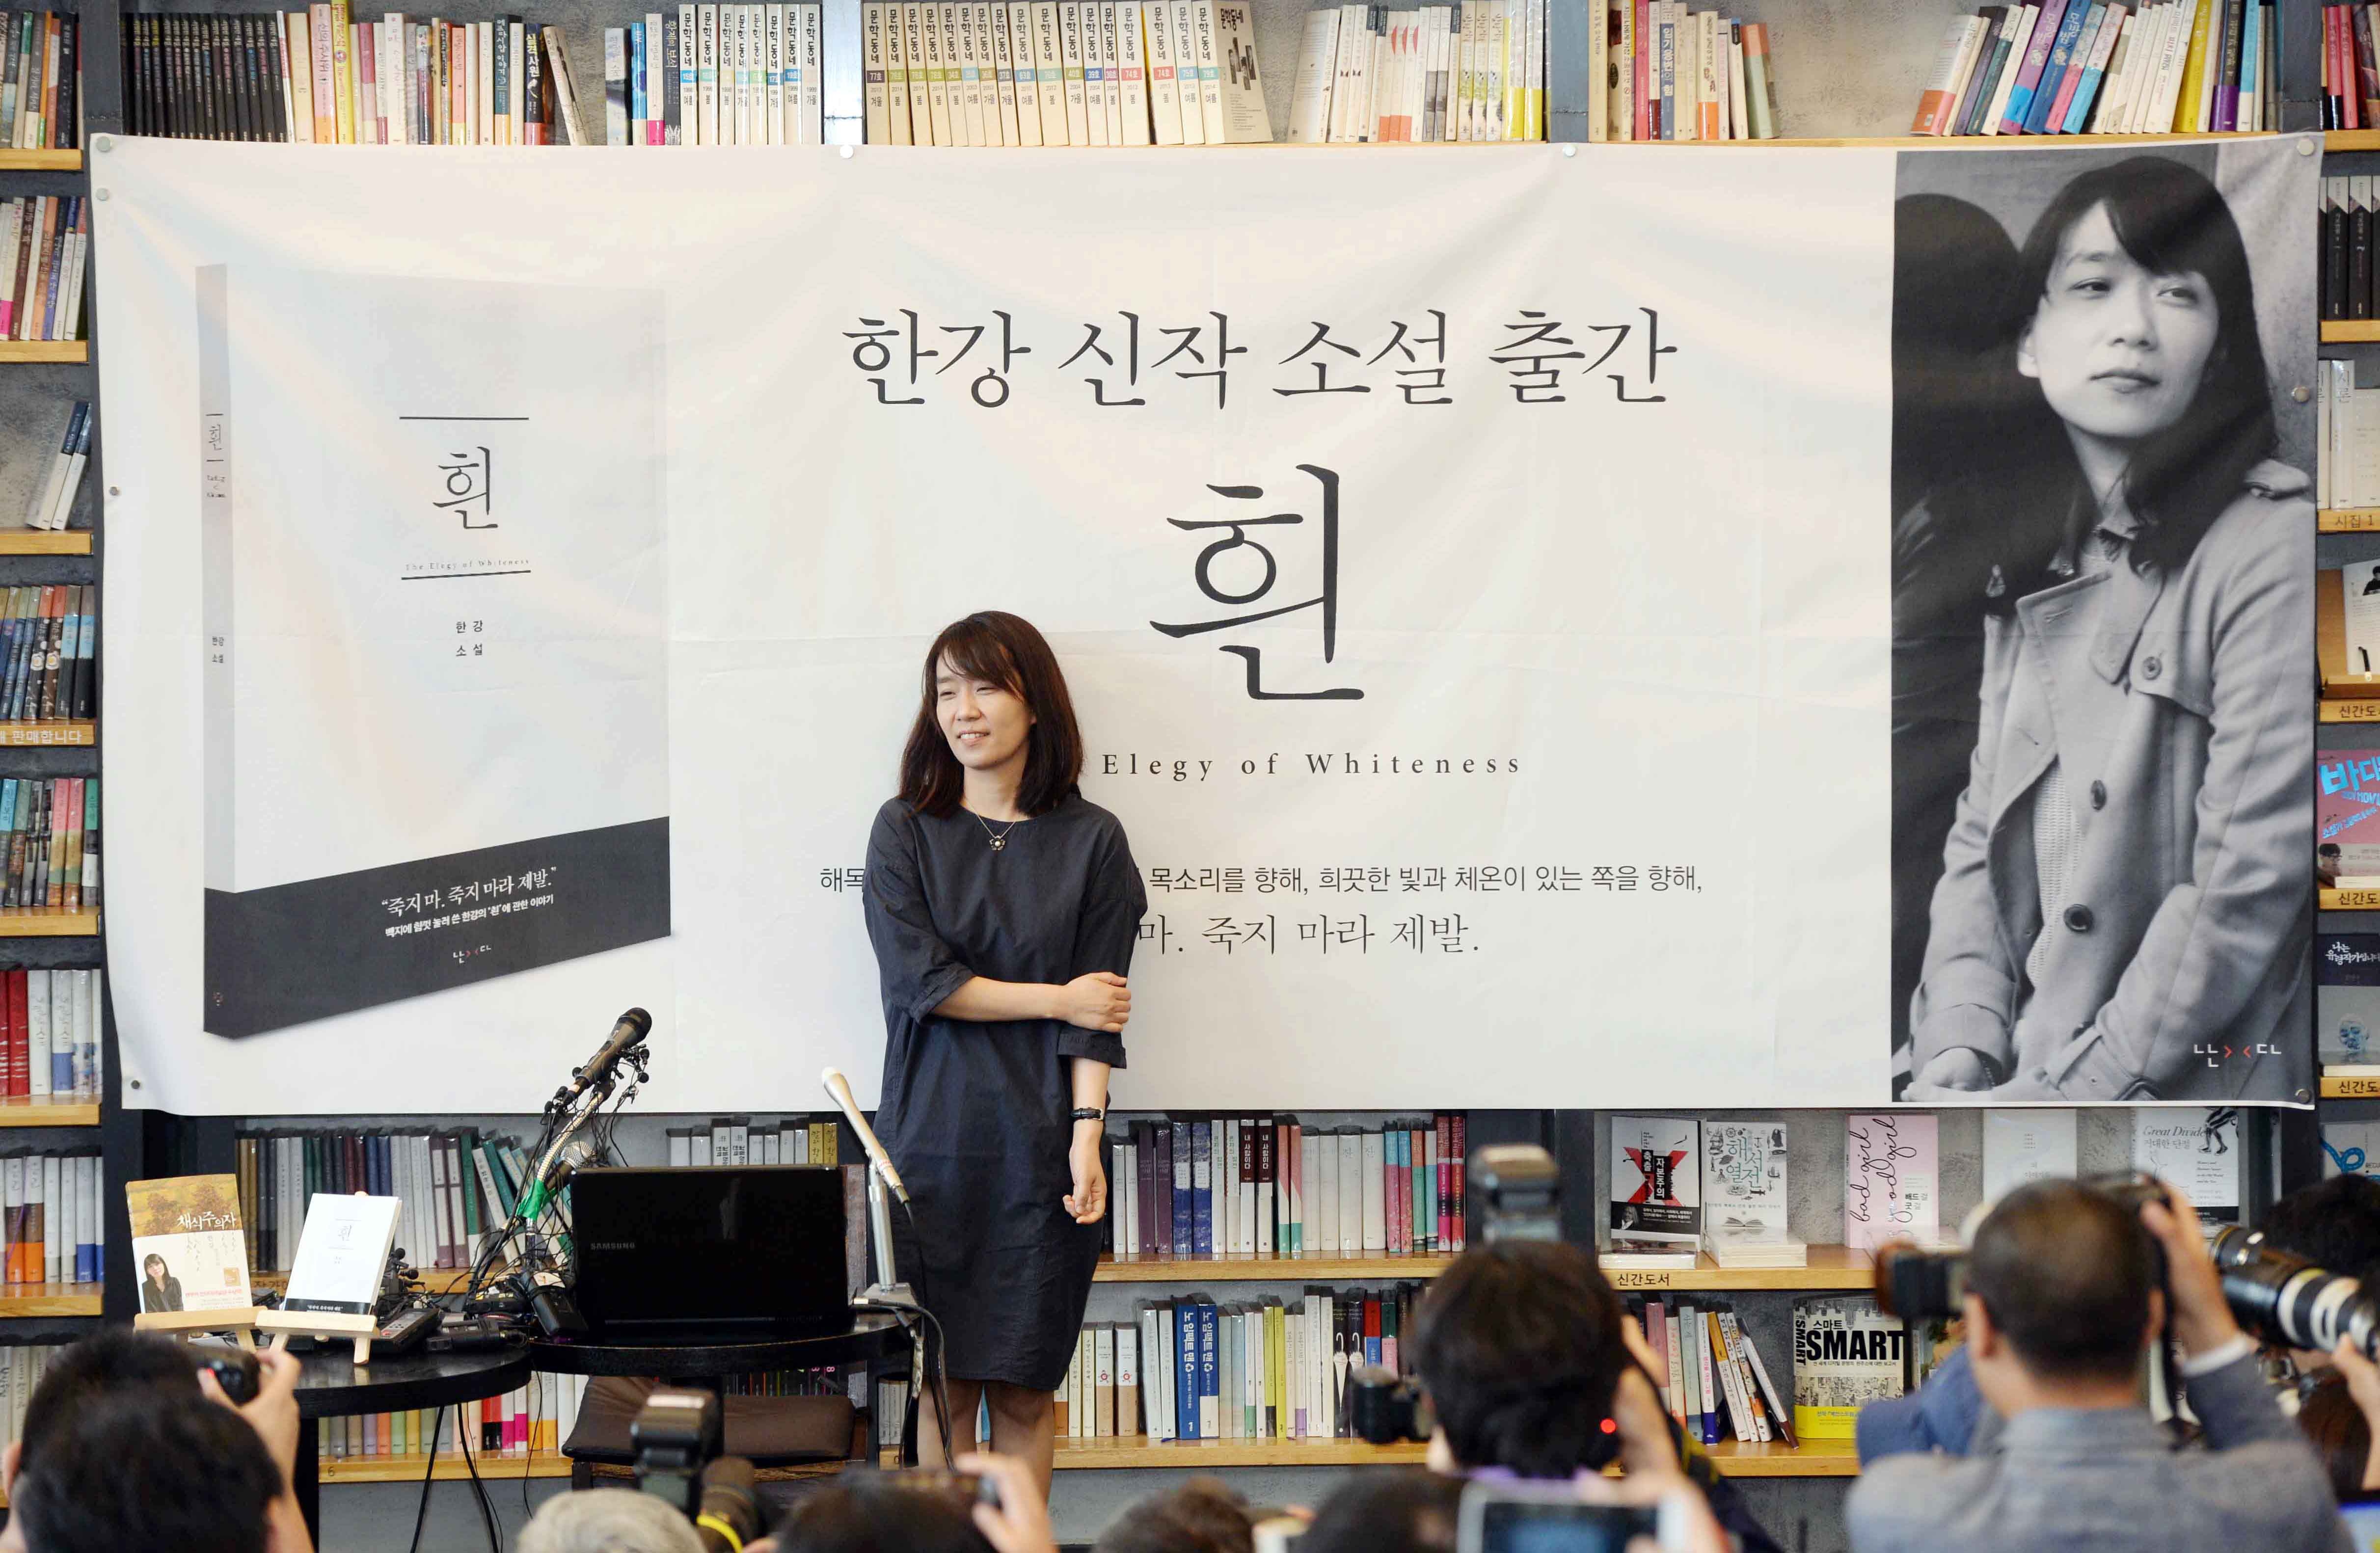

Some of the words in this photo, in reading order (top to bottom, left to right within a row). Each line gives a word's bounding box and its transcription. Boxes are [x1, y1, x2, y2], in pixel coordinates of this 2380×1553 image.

[869, 10, 880, 63] 문학동네
[889, 9, 899, 62] 문학동네
[909, 9, 919, 61] 문학동네
[926, 9, 938, 61] 문학동네
[945, 8, 956, 61] 문학동네
[962, 8, 973, 61] 문학동네
[977, 8, 989, 61] 문학동네
[995, 9, 1007, 61] 문학동네
[1016, 9, 1028, 61] 문학동네
[1041, 8, 1053, 61] 문학동네
[1066, 6, 1077, 59] 문학동네
[1086, 7, 1097, 60] 문학동네
[1104, 7, 1115, 60] 문학동네
[1124, 7, 1135, 60] 문학동네
[1154, 7, 1165, 59] 문학동네
[1179, 7, 1190, 59] 문학동네
[1199, 7, 1211, 60] 문학동네
[842, 309, 1031, 407] 한강
[1058, 311, 1247, 409] 신작
[1272, 310, 1452, 404] 소설
[1488, 307, 1677, 402] 출간
[433, 447, 498, 529] 흰
[2335, 515, 2360, 528] 시집
[1150, 464, 1364, 700] 흰
[2339, 705, 2380, 718] 신간도
[11, 730, 82, 744] 판매합니다
[1102, 753, 1212, 781] Elegy
[1242, 753, 1278, 774] of
[1305, 753, 1517, 774] Whiteness
[424, 889, 445, 910] 마.
[447, 882, 479, 906] 죽지
[483, 875, 514, 898] 마라
[1150, 868, 1246, 891] 목소리를
[1255, 867, 1310, 893] 향해,
[1318, 867, 1390, 892] 희끗한
[1399, 867, 1446, 892] 빛과
[1455, 867, 1526, 892] 체온이
[1534, 867, 1582, 892] 있는
[1590, 867, 1639, 892] 쪽을
[1647, 866, 1704, 893] 향해,
[2339, 893, 2380, 905] 신간도
[385, 923, 412, 938] 백지에
[461, 908, 487, 923] 한강의
[512, 899, 529, 911] 관한
[530, 894, 554, 907] 이야기
[1202, 914, 1278, 955] 죽지
[1297, 914, 1376, 954] 마라
[1391, 914, 1479, 955] 제발.
[2332, 942, 2351, 953] 나는
[2339, 1081, 2380, 1093] 신간도
[1849, 1127, 1890, 1172] girl
[1872, 1116, 1917, 1160] girl
[2143, 1126, 2171, 1136] Great
[177, 1210, 236, 1230] 채식주의자
[1850, 1176, 1870, 1222] bad
[1618, 1273, 1670, 1286] 신간도서
[1184, 1312, 1194, 1322] 노
[1184, 1323, 1194, 1351] 임팩트
[1202, 1323, 1213, 1351] 임팩트
[1203, 1312, 1213, 1321] 노
[1812, 1319, 1843, 1330] 스마트
[1184, 1353, 1194, 1362] 맨
[1203, 1353, 1214, 1362] 맨
[1795, 1319, 1806, 1366] SMART
[1807, 1330, 1905, 1361] SMART
